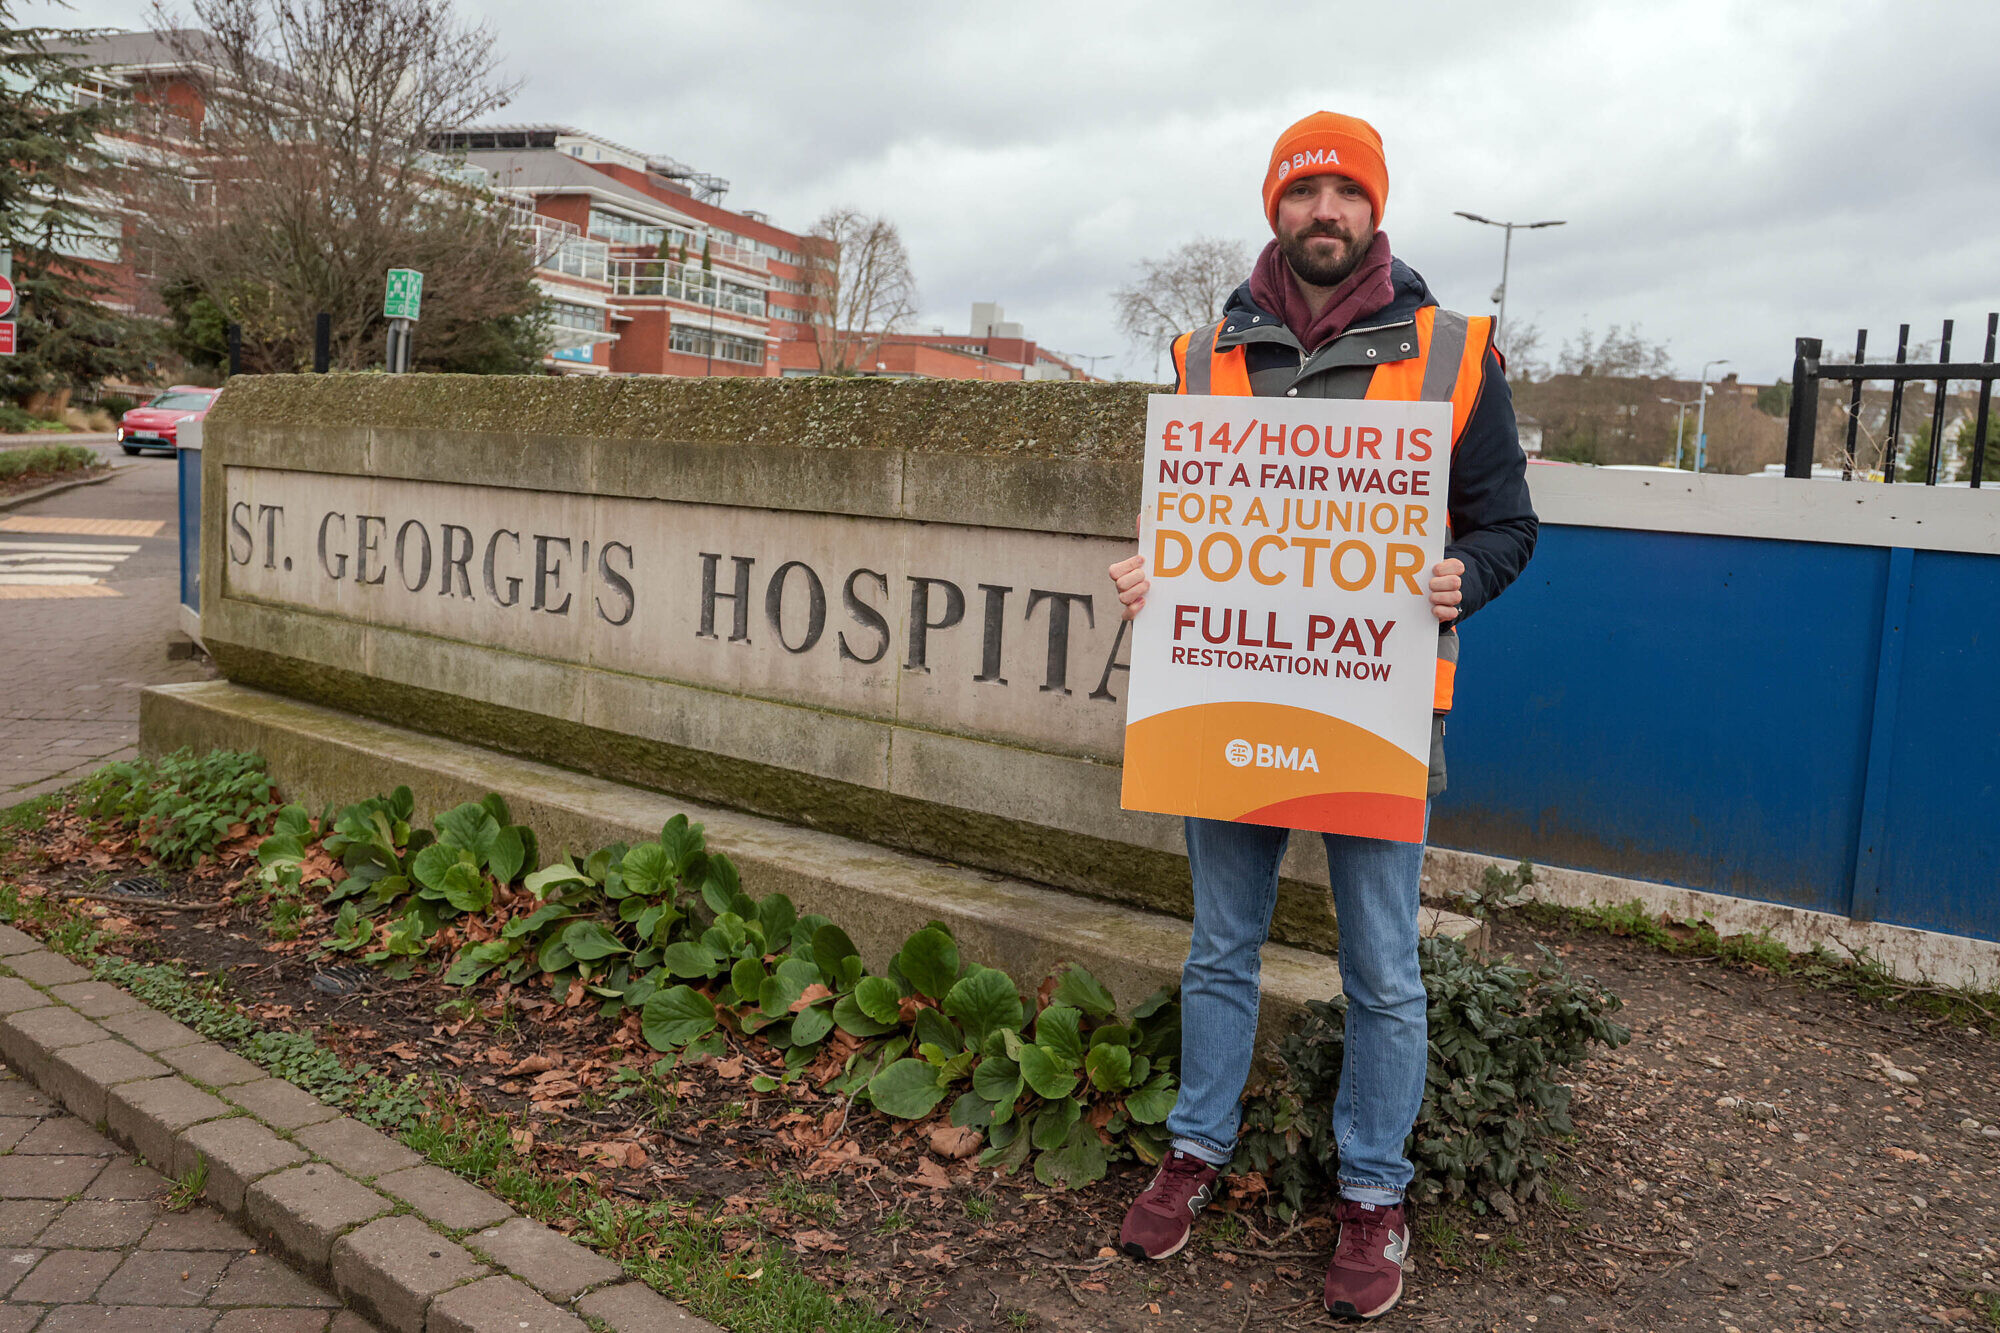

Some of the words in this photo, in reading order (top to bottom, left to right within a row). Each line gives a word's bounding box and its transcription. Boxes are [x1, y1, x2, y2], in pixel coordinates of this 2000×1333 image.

[1293, 149, 1340, 169] BMA
[1161, 419, 1383, 460] £14/HOUR
[1395, 428, 1433, 462] IS
[1158, 459, 1224, 486] NOT
[1228, 462, 1251, 488] A
[1259, 463, 1329, 492] FAIR
[1337, 466, 1431, 496] WAGE
[1156, 491, 1234, 526] FOR
[1242, 496, 1270, 528] A
[1276, 497, 1429, 537] JUNIOR
[229, 500, 294, 574] ST.
[316, 510, 636, 627] GEORGE'S
[1153, 528, 1426, 596] DOCTOR
[1173, 604, 1293, 650] FULL
[1306, 614, 1397, 658] PAY
[1171, 646, 1329, 678] RESTORATION
[1335, 660, 1392, 683] NOW
[1255, 743, 1320, 773] BMA
